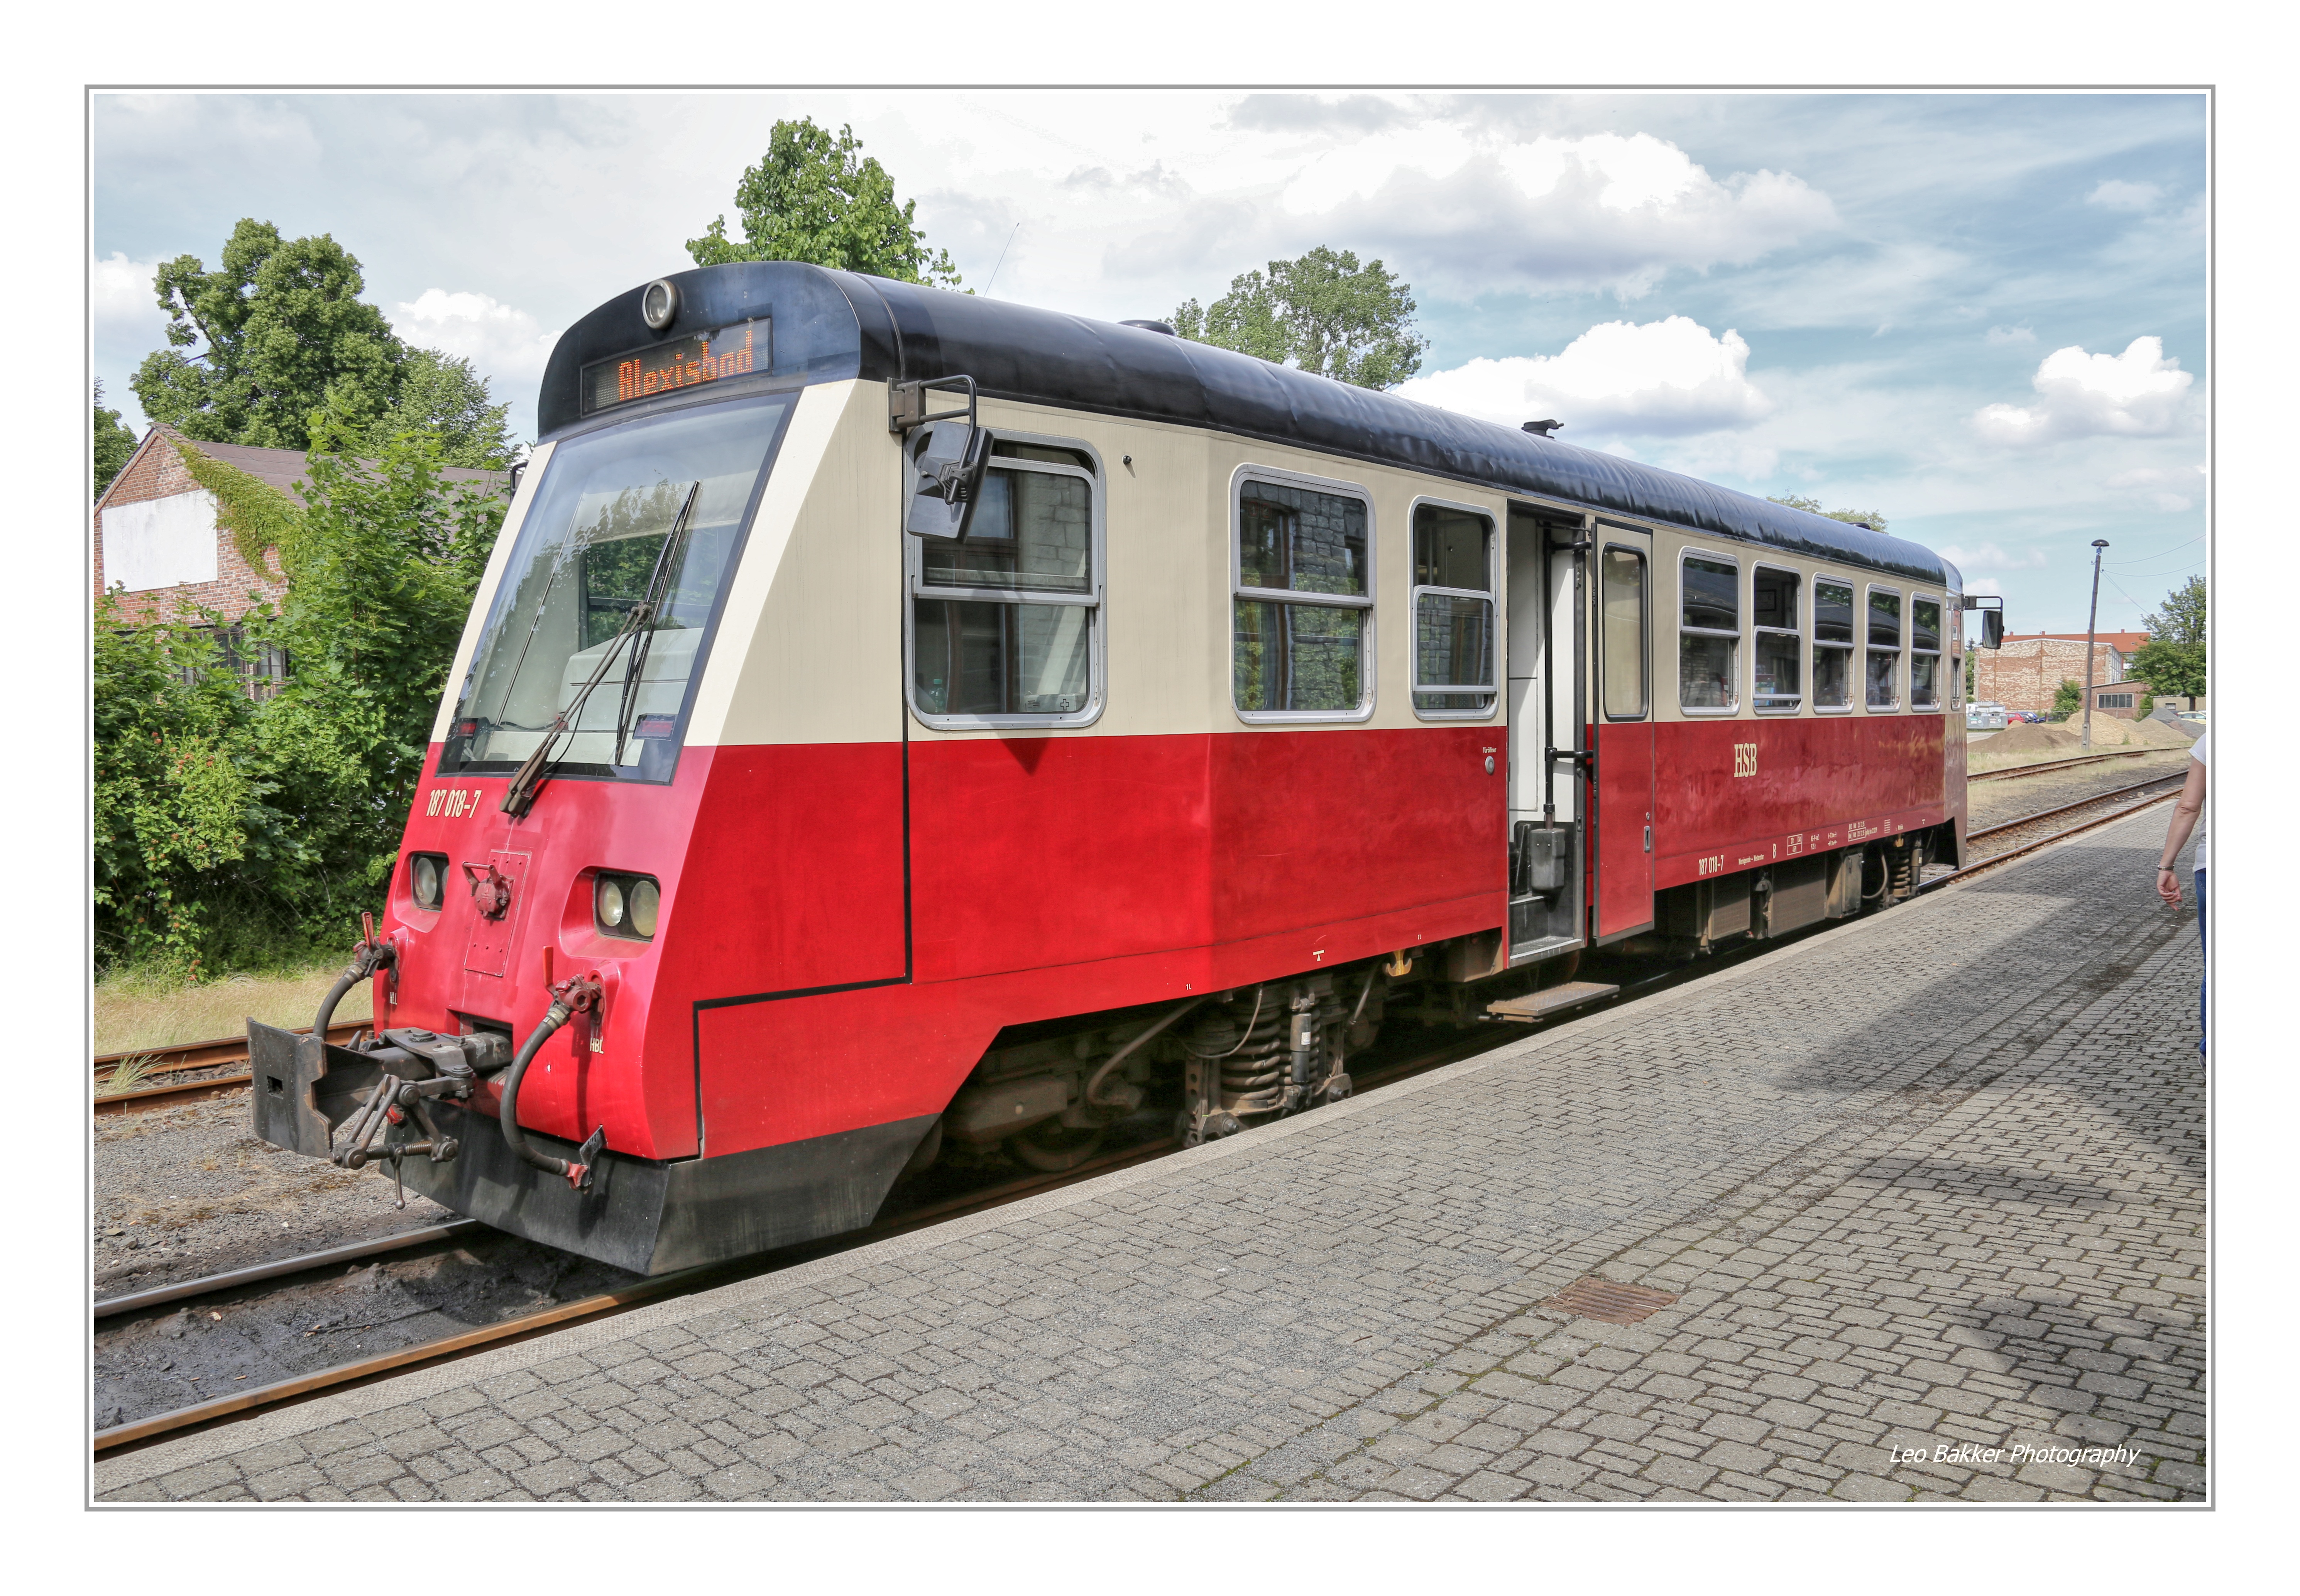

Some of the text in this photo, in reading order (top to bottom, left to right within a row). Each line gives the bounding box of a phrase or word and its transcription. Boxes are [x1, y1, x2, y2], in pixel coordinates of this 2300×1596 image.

[619, 330, 753, 401] Alexisbad
[1734, 742, 1757, 778] HSB
[426, 789, 482, 818] 187 018-7
[1772, 843, 1776, 859] B
[1698, 854, 1724, 876] 187 018-7
[589, 1037, 604, 1054] HBL
